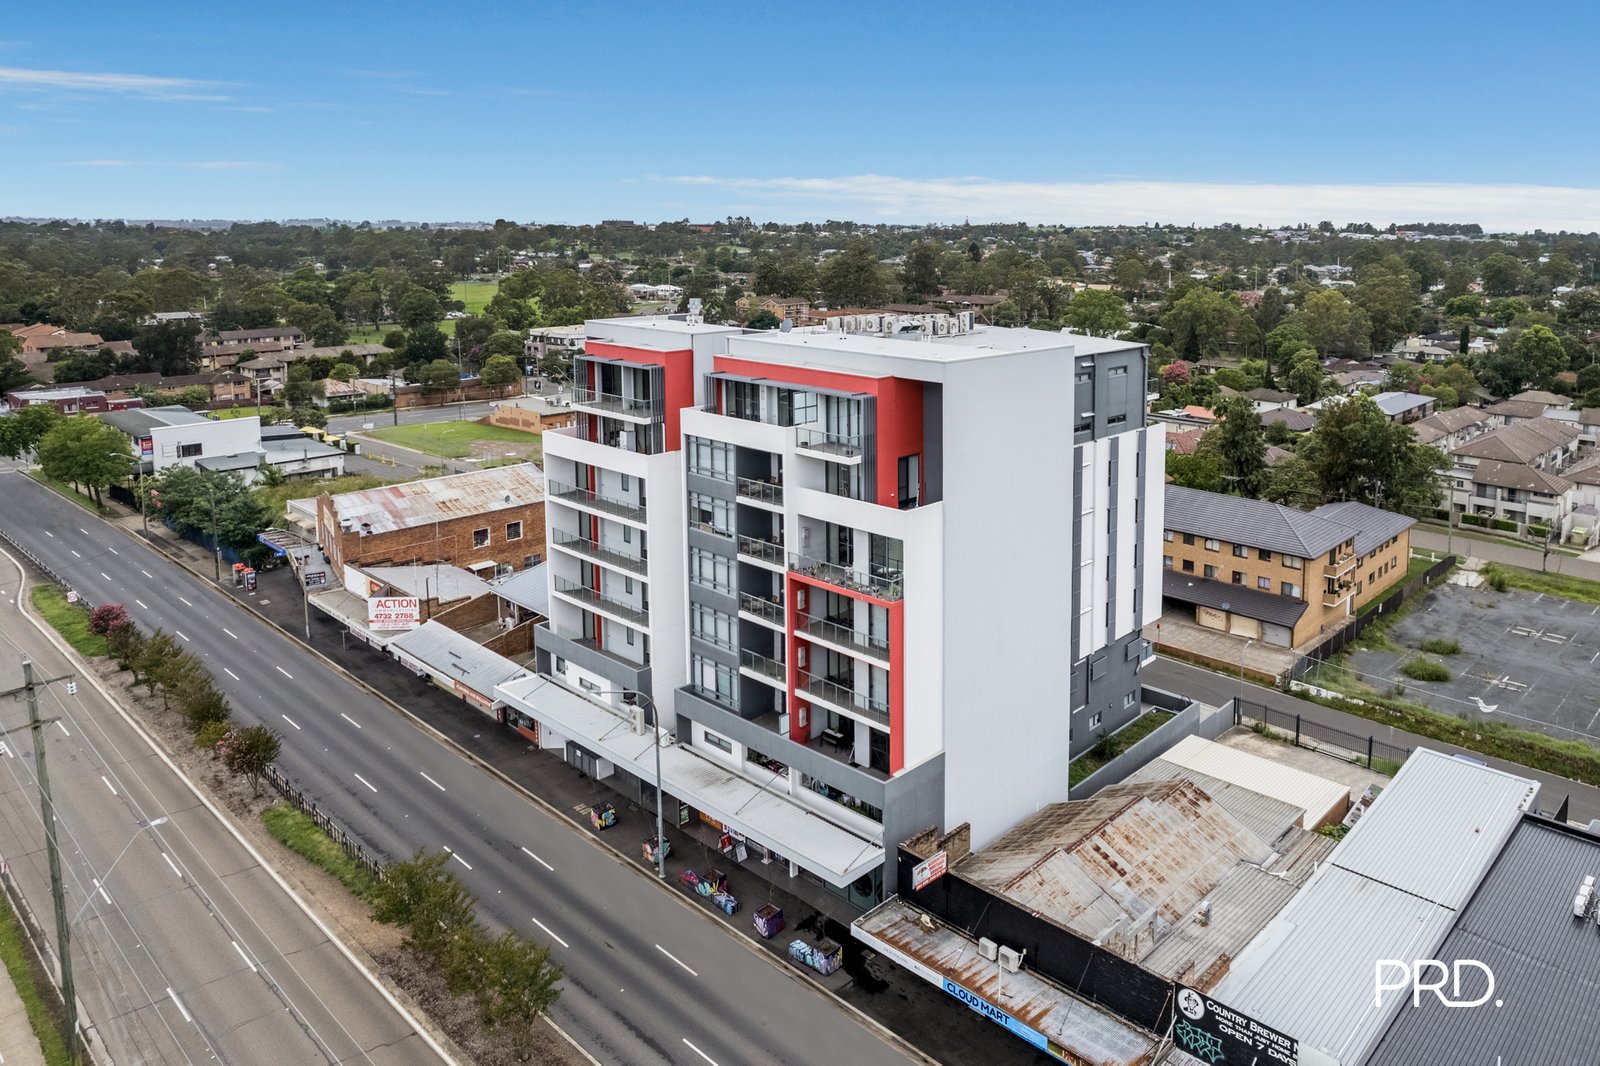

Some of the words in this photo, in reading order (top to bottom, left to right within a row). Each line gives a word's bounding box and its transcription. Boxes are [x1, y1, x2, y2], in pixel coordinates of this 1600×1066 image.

[376, 599, 417, 608] ACTION
[946, 982, 979, 1008] CLOUD
[980, 1002, 1011, 1025] MART
[1206, 1000, 1248, 1027] COUNTRY
[1249, 1021, 1291, 1050] BREWER
[1215, 1015, 1233, 1028] MORE
[1235, 1024, 1253, 1037] THAN
[1254, 1035, 1270, 1045] JUST
[1271, 1043, 1291, 1057] HOME
[1219, 1024, 1253, 1046] OPEN
[1255, 1041, 1265, 1050] 7
[1267, 1047, 1297, 1066] DAYS
